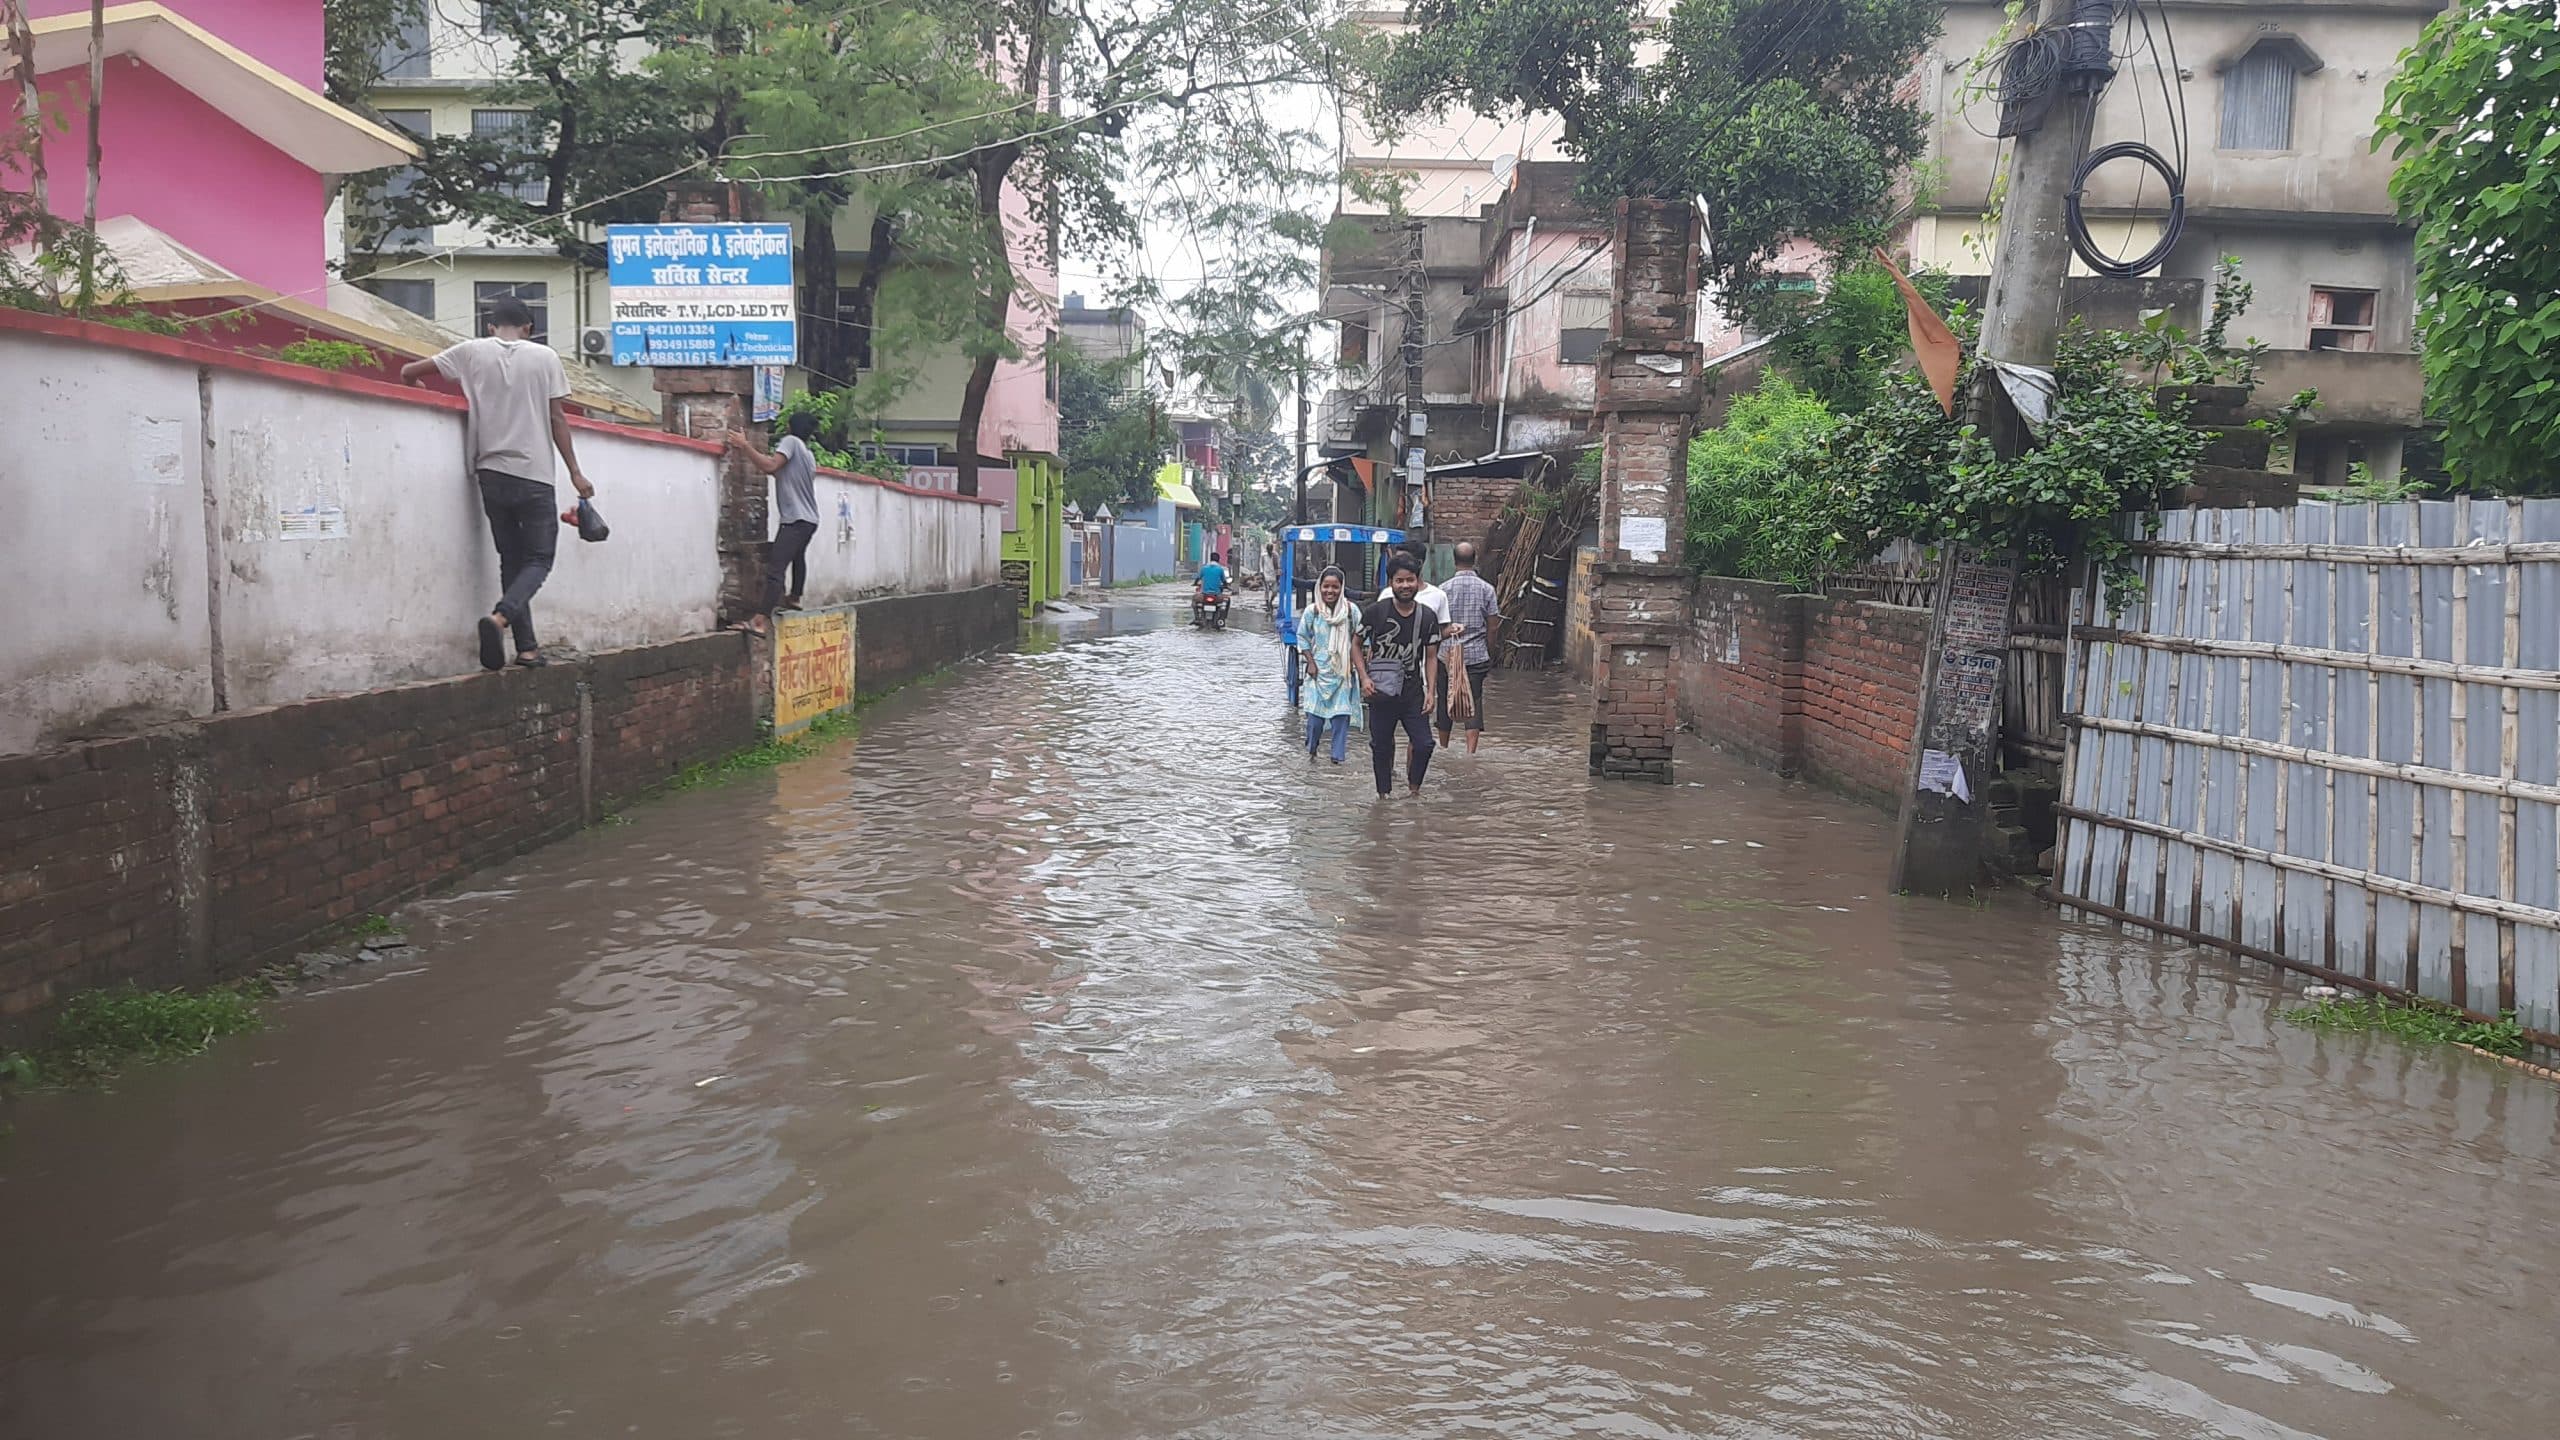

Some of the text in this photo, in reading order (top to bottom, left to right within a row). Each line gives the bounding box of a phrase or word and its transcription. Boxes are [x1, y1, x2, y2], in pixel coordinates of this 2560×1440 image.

[610, 234, 641, 264] सुमन
[712, 234, 721, 256] &
[651, 264, 701, 285] सर्विस
[771, 304, 789, 317] TV
[615, 325, 641, 336] Call
